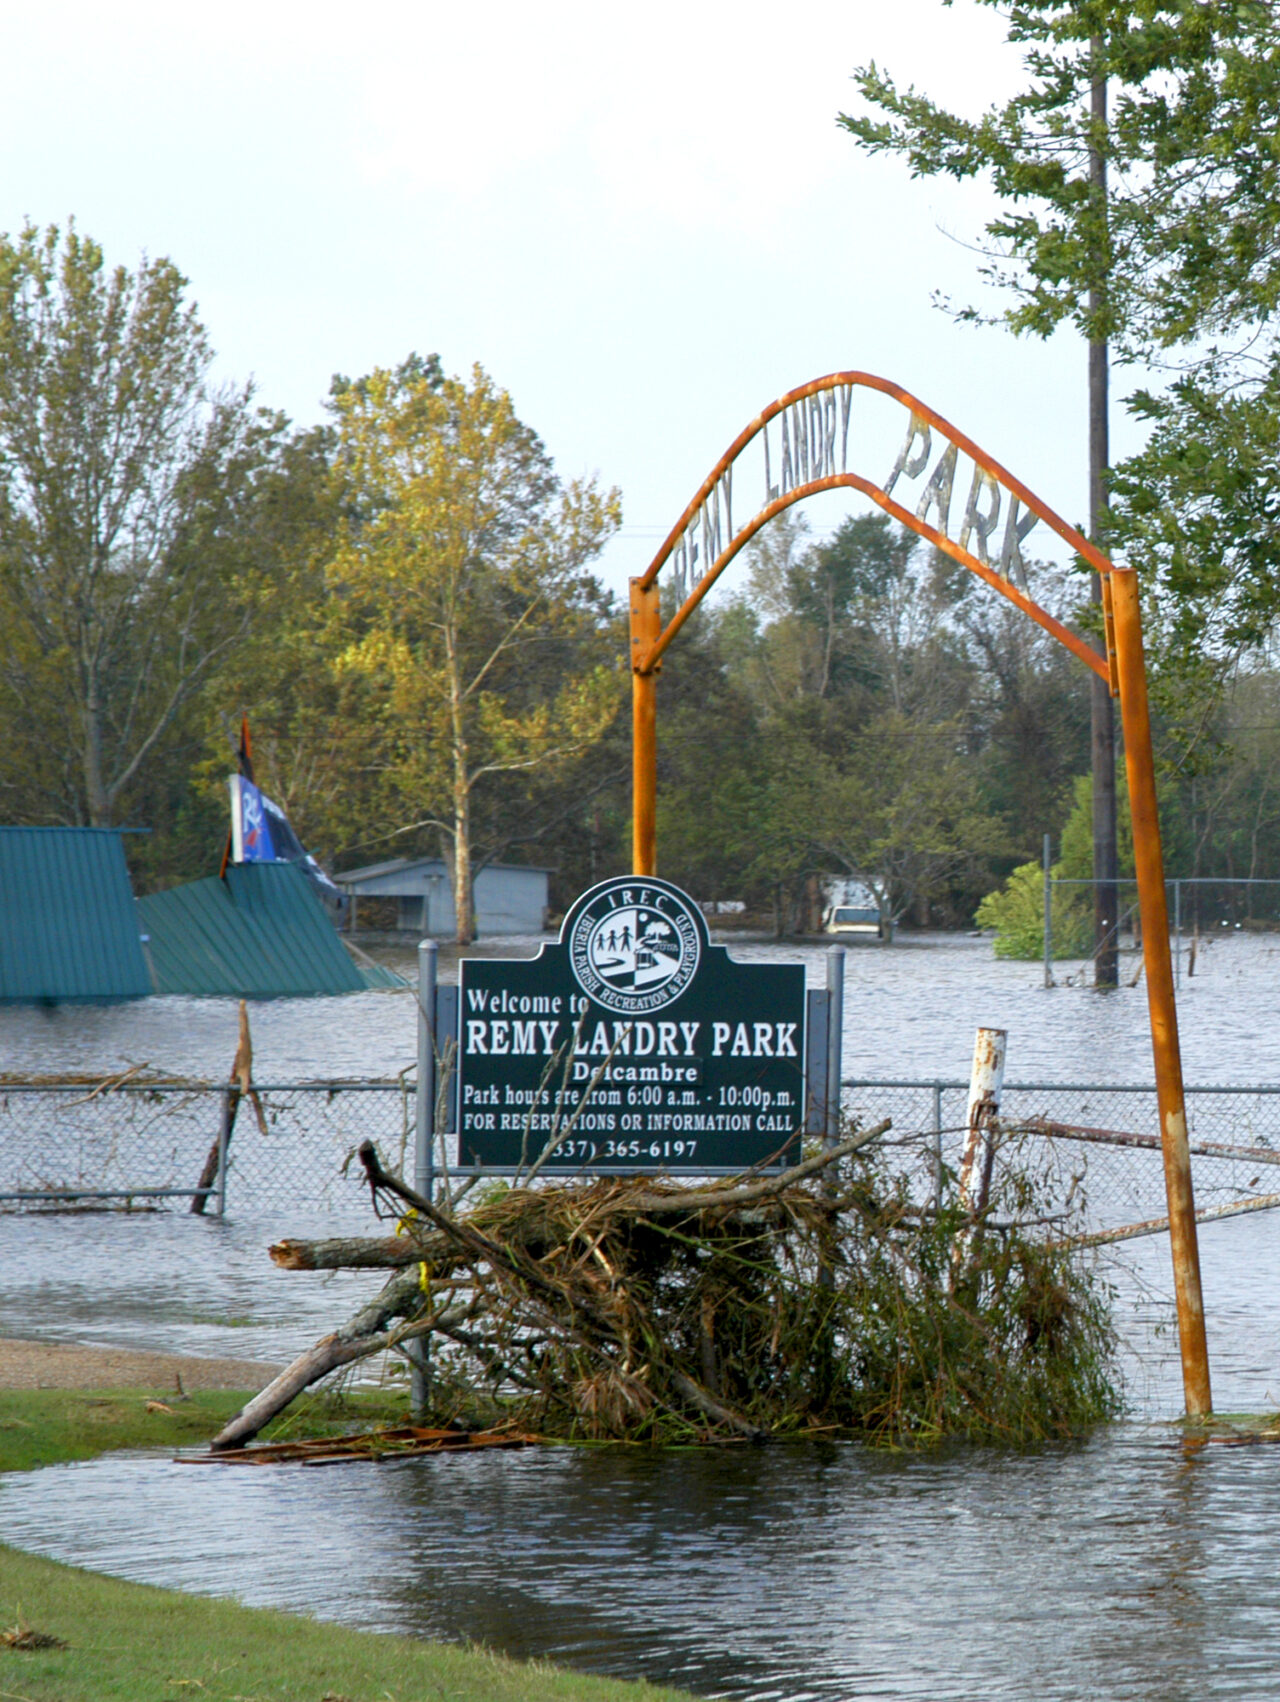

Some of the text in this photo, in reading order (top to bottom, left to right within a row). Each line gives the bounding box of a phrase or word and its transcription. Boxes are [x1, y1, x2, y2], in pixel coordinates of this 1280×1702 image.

[673, 383, 1040, 612] REMY LANDRY PARK
[607, 889, 669, 910] IREC
[573, 913, 699, 1011] IBERIA PARISH RECREATION & PLAYGROUND
[467, 988, 590, 1014] Welcome to
[465, 1020, 798, 1057] REMY LANDRY PARK
[572, 1061, 698, 1082] Delcambre
[463, 1084, 500, 1105] Park
[554, 1089, 580, 1105] are
[582, 1086, 622, 1106] rom
[627, 1086, 663, 1106] 6:00
[667, 1089, 702, 1106] a.m.
[719, 1086, 796, 1112] 10:00p.m.
[463, 1113, 794, 1132] FOR RESERVATIONS OR INFORMATION CALL
[542, 1139, 697, 1161] (337) 365-6197
